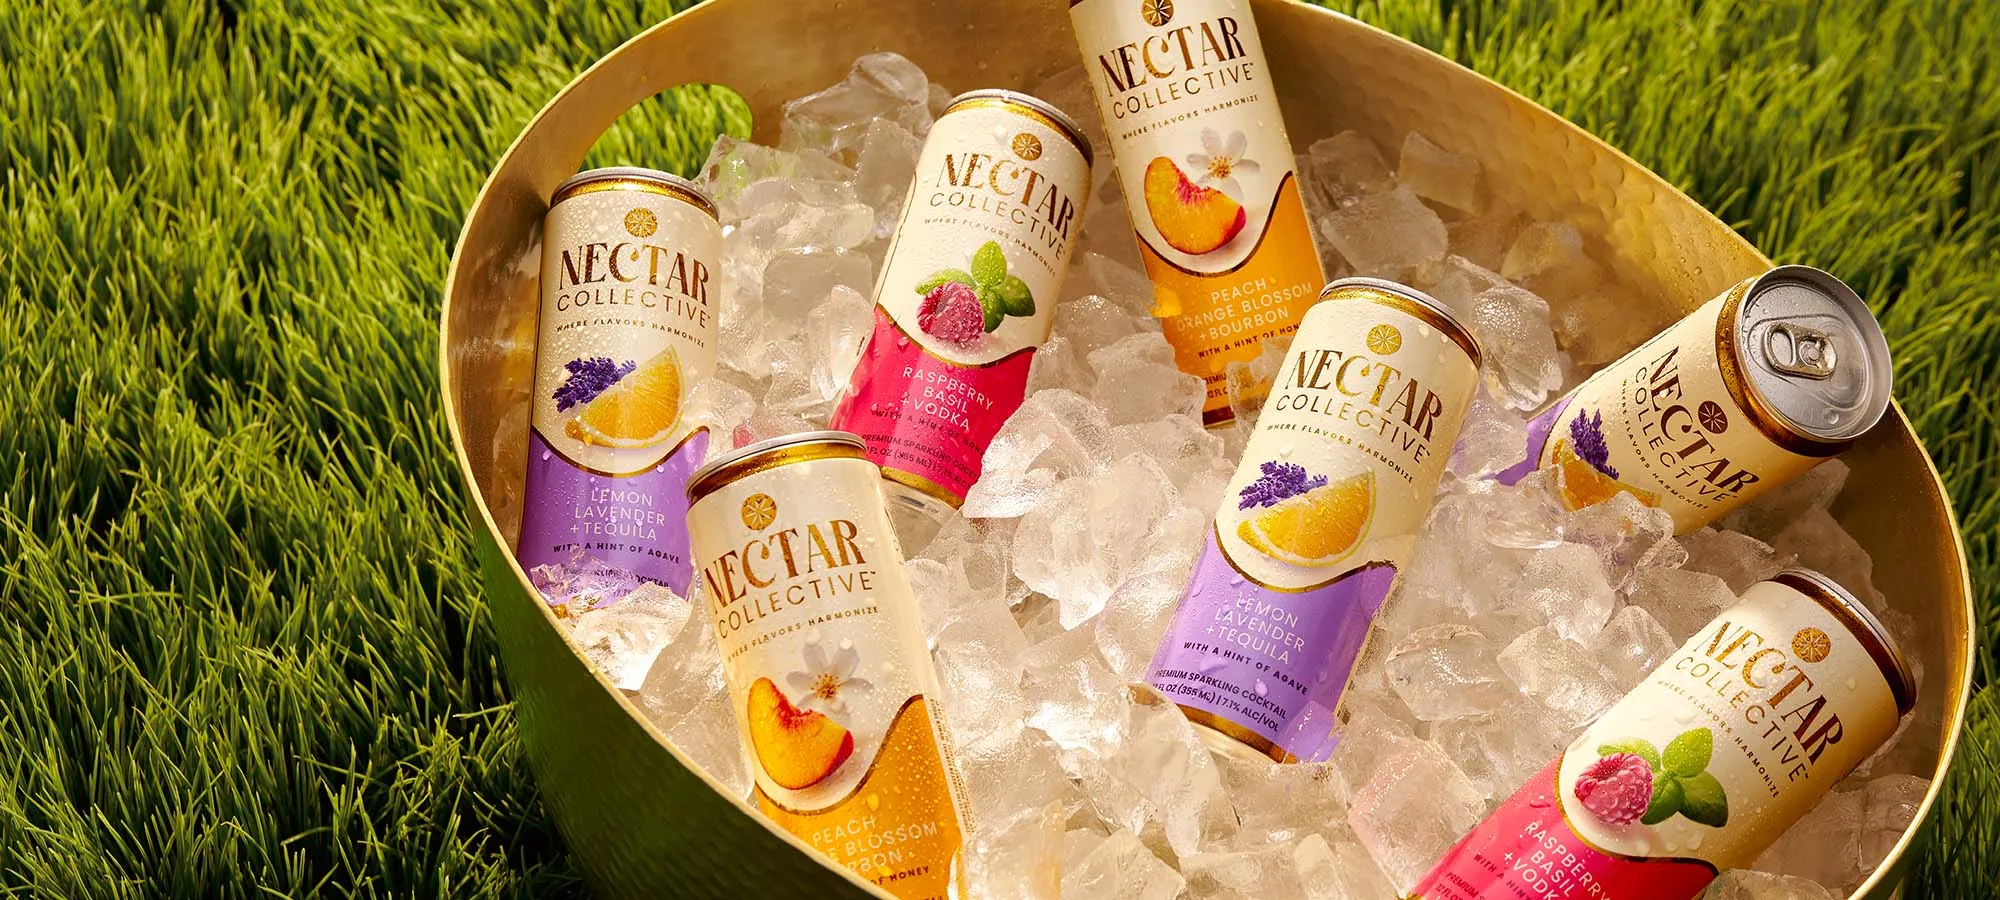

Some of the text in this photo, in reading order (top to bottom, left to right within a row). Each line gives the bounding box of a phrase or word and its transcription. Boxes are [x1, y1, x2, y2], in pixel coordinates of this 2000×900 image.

[1098, 16, 1247, 97] NECTAR
[1113, 63, 1253, 119] COLLECTIVE
[1122, 95, 1258, 140] WHERE FLAVORS HARMONIZE
[936, 152, 1075, 241] NECTAR
[930, 192, 1064, 261] COLLECTIVE
[962, 219, 1009, 239] FLAVORS
[558, 242, 709, 307] NECTAR
[1211, 277, 1268, 304] PEACH
[557, 289, 708, 329] COLLECTIVE
[1177, 282, 1314, 332] ORANGE BLOSSOM
[556, 318, 705, 348] WHERE FLAVORS HARMONIZE
[1198, 347, 1220, 359] WITH
[1234, 336, 1258, 348] HINT
[1262, 330, 1275, 339] OF
[1279, 322, 1302, 335] HON
[902, 366, 993, 412] RASPBERRY
[924, 386, 968, 414] BASIL
[1285, 349, 1443, 442] NECTAR
[1276, 394, 1427, 464] COLLECTIVE
[1635, 367, 1732, 502] COLLECTIVE
[1650, 345, 1760, 494] NECTAR
[903, 439, 952, 463] SPARKLING
[1301, 425, 1352, 445] FLAVORS
[1358, 443, 1414, 484] HARMONIZE
[1625, 420, 1650, 468] FLAVORS
[1652, 473, 1709, 509] HARMONIZE
[575, 506, 665, 527] LAVENDER
[591, 489, 653, 506] LEMON
[596, 542, 624, 551] HINT
[629, 545, 644, 553] OF
[647, 548, 680, 564] AGAVE
[704, 519, 866, 614] NECTAR
[718, 571, 873, 639] COLLECTIVE
[752, 623, 801, 647] FLAVORS
[808, 606, 879, 626] HARMONIZE
[1236, 592, 1299, 629] LEMON
[1214, 608, 1305, 653] LAVENDER
[1183, 642, 1308, 696] WITH A HINT OF AGAVE
[1155, 669, 1288, 719] PREMIUM SPARKLING COCKTAIL
[1166, 683, 1178, 693] OZ
[1177, 683, 1198, 697] (355
[1221, 698, 1240, 712] 7.1%
[1241, 706, 1280, 732] ALC/VOL
[1693, 621, 1843, 766] NECTAR
[1675, 656, 1806, 782] COLLECTIVE
[1687, 695, 1732, 734] FLAVORS
[1734, 736, 1780, 799] HARMONIZE
[812, 815, 877, 847] PEACH
[845, 821, 938, 857] BLOSSOM
[889, 865, 930, 882] HONEY
[1474, 854, 1497, 872] WITH
[1496, 872, 1504, 880] A
[1530, 850, 1575, 897] BASIL
